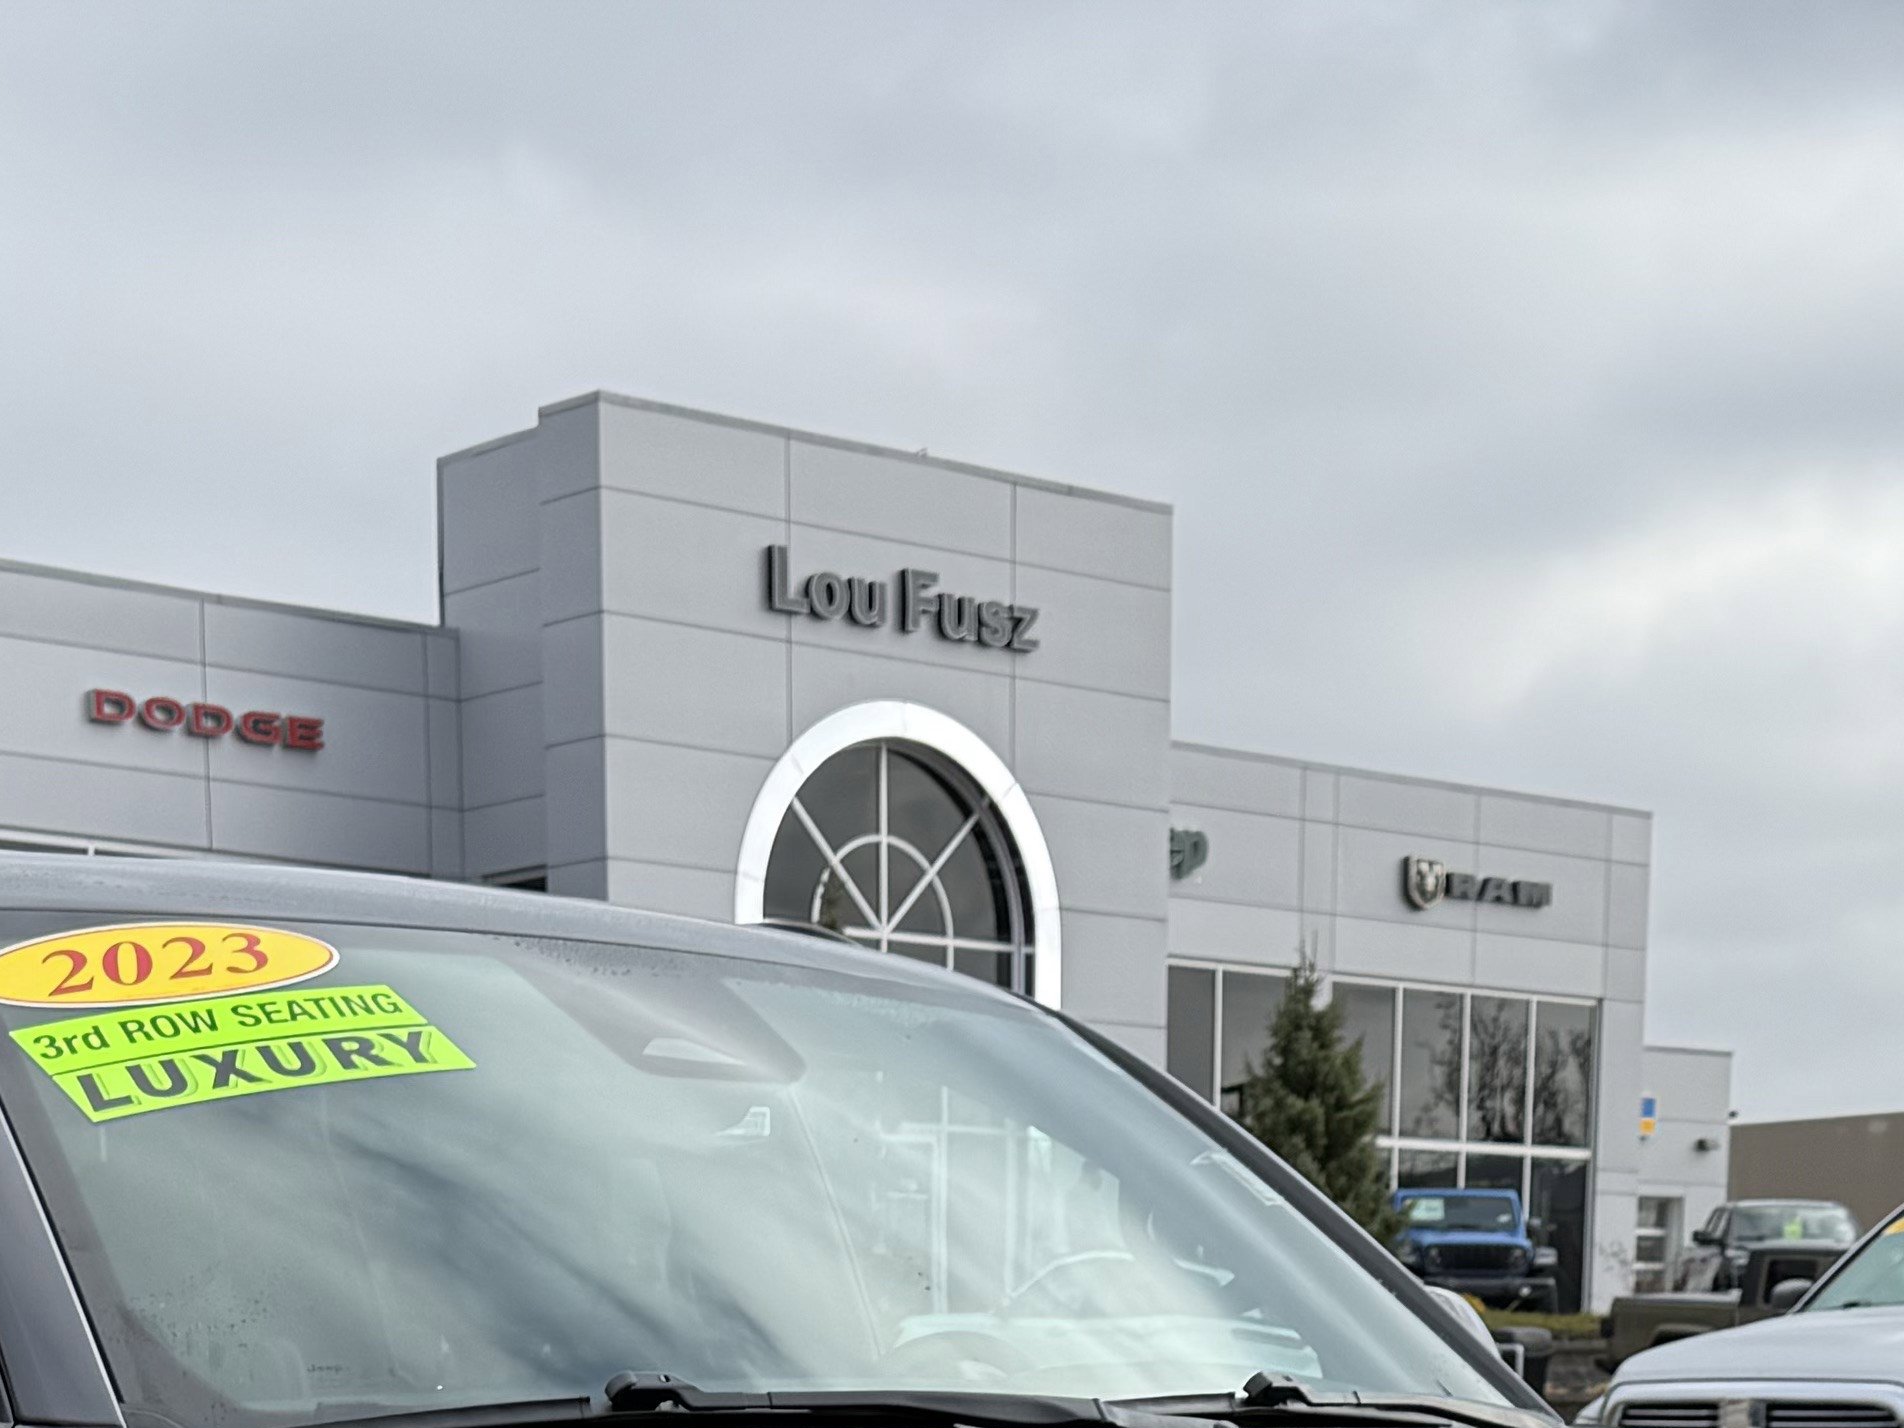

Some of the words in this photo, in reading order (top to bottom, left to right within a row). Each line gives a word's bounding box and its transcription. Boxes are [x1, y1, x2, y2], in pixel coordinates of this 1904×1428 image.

[767, 544, 888, 628] Lou
[900, 567, 1041, 652] Fusz
[89, 688, 325, 750] DODGE
[1445, 872, 1553, 908] RAM
[41, 932, 270, 998] 2023
[33, 1026, 107, 1061] 3rd
[119, 1008, 220, 1046] ROW
[236, 991, 404, 1028] SEATING
[76, 1031, 441, 1113] LUXURY
